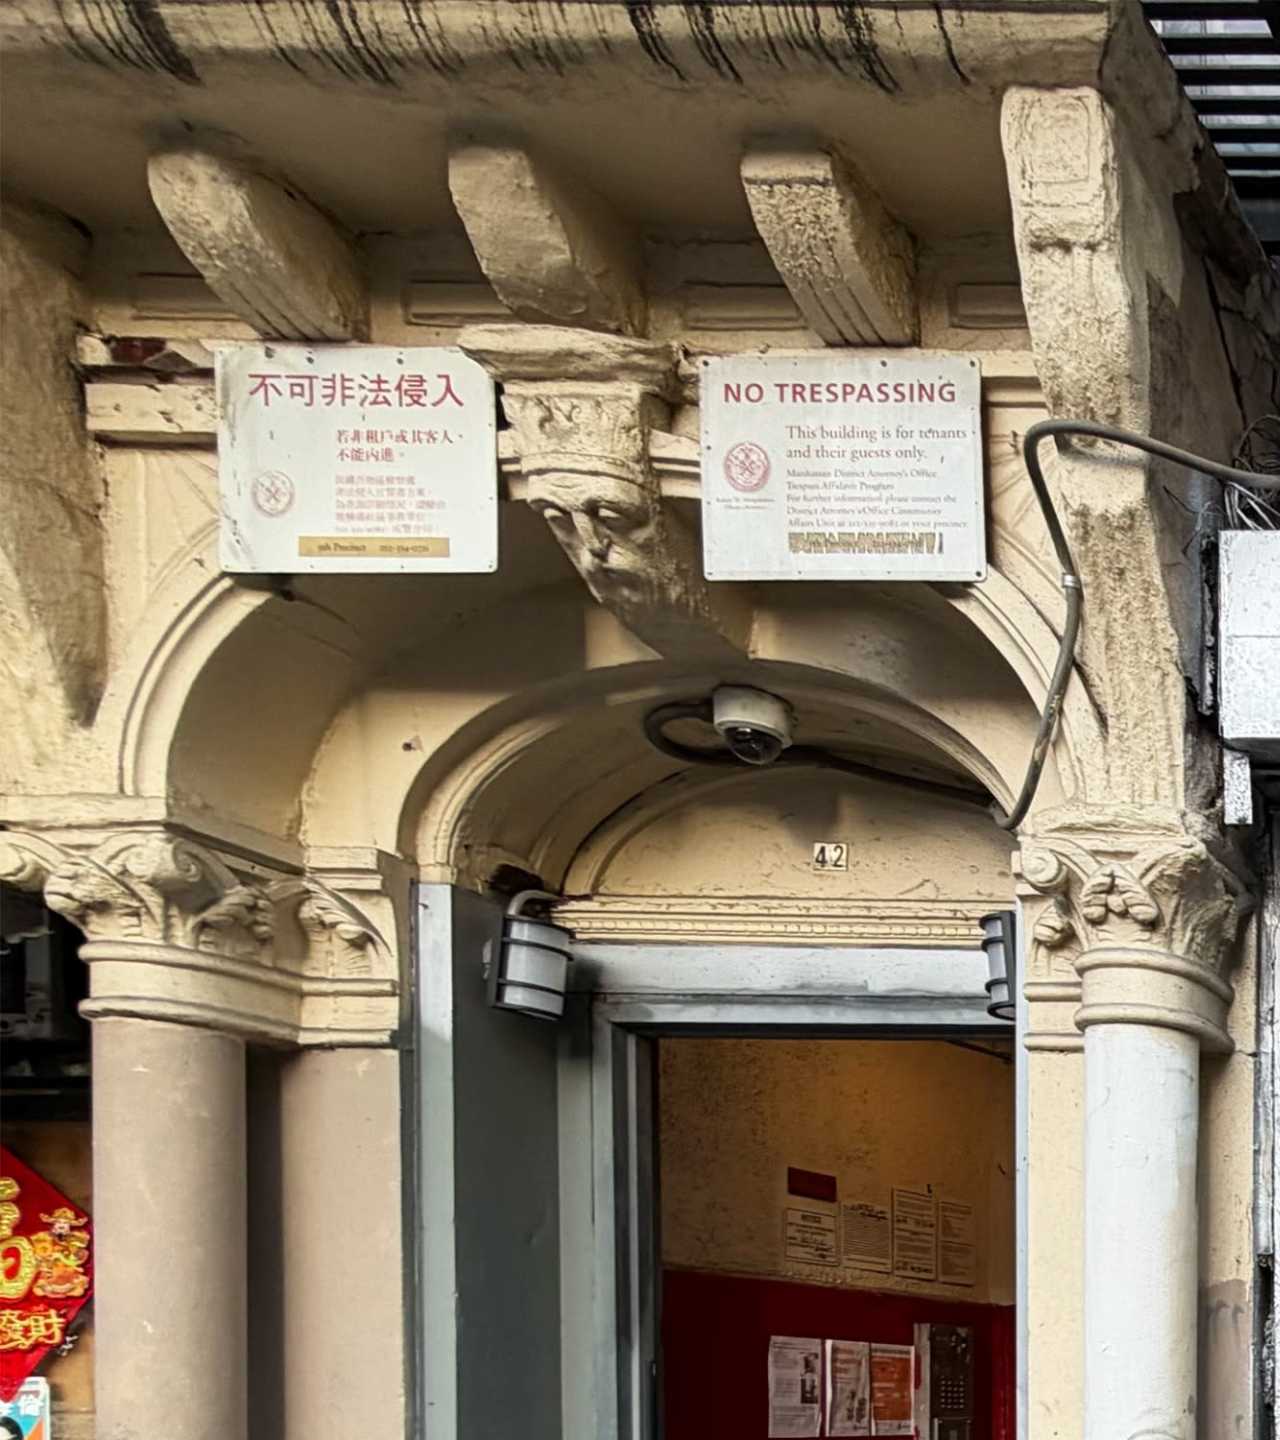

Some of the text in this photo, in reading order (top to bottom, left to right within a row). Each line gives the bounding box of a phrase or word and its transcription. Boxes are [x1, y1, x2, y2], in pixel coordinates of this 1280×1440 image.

[247, 373, 465, 408] 不可非法侵入
[723, 383, 957, 403] NO TRESPASSING
[785, 425, 967, 443] This building is for tenants
[785, 445, 928, 463] and their guests only.
[815, 845, 845, 868] 42
